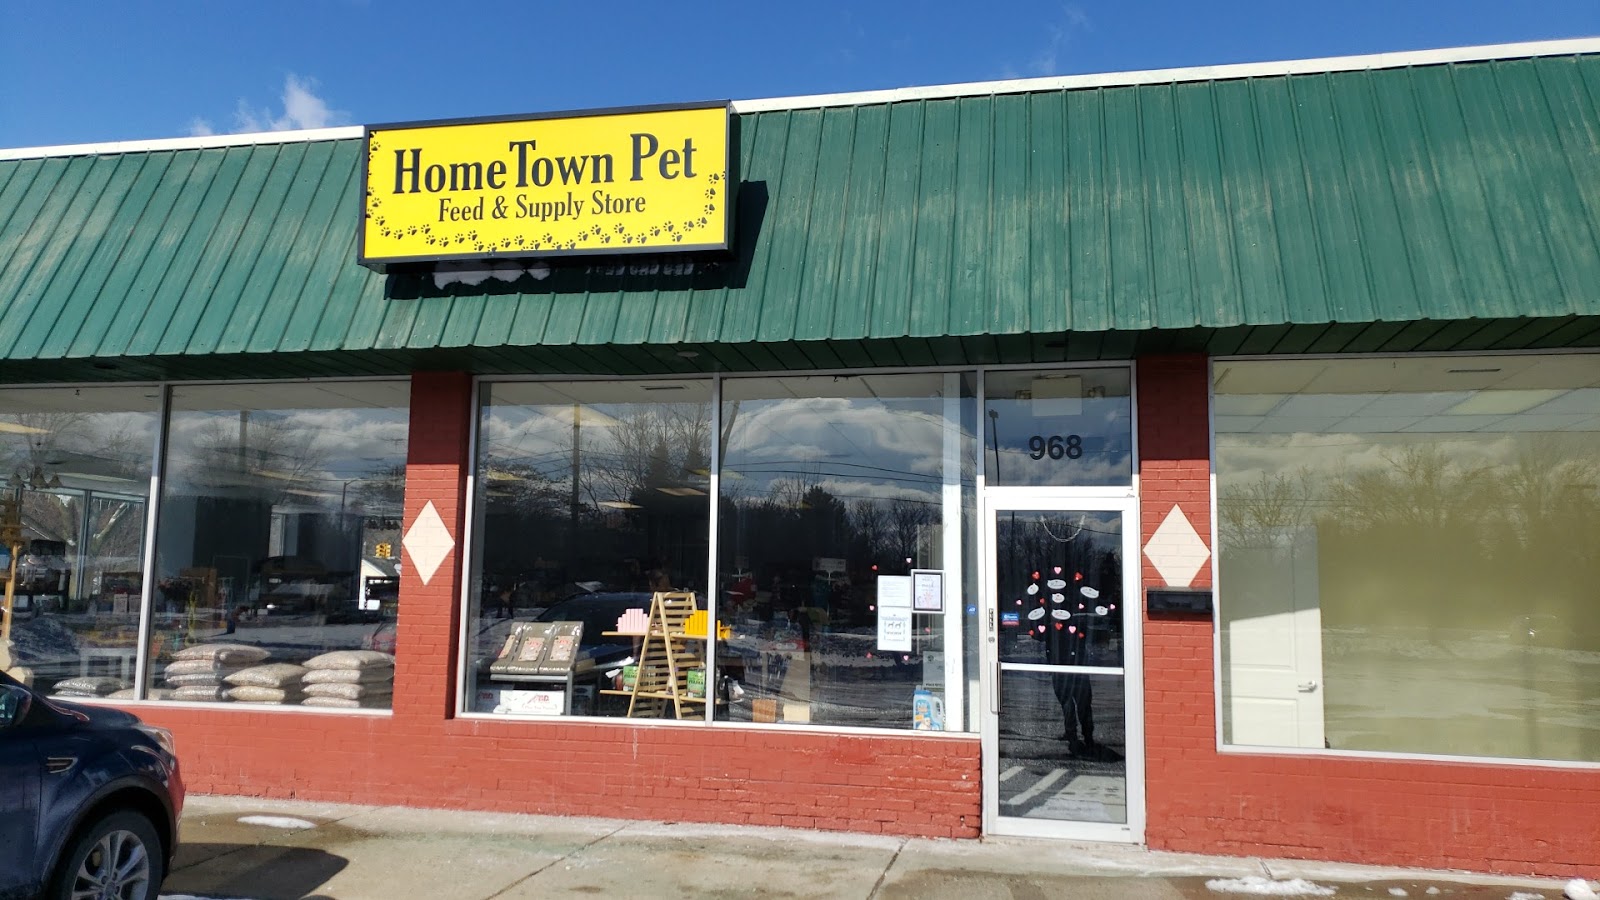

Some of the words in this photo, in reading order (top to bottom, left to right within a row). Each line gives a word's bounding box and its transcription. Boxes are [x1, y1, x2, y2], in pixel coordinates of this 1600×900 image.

[630, 133, 697, 182] Pet
[439, 198, 484, 222] Feed
[491, 195, 508, 220] &
[516, 193, 584, 223] Supply
[592, 188, 646, 214] Store
[1029, 435, 1083, 460] 968
